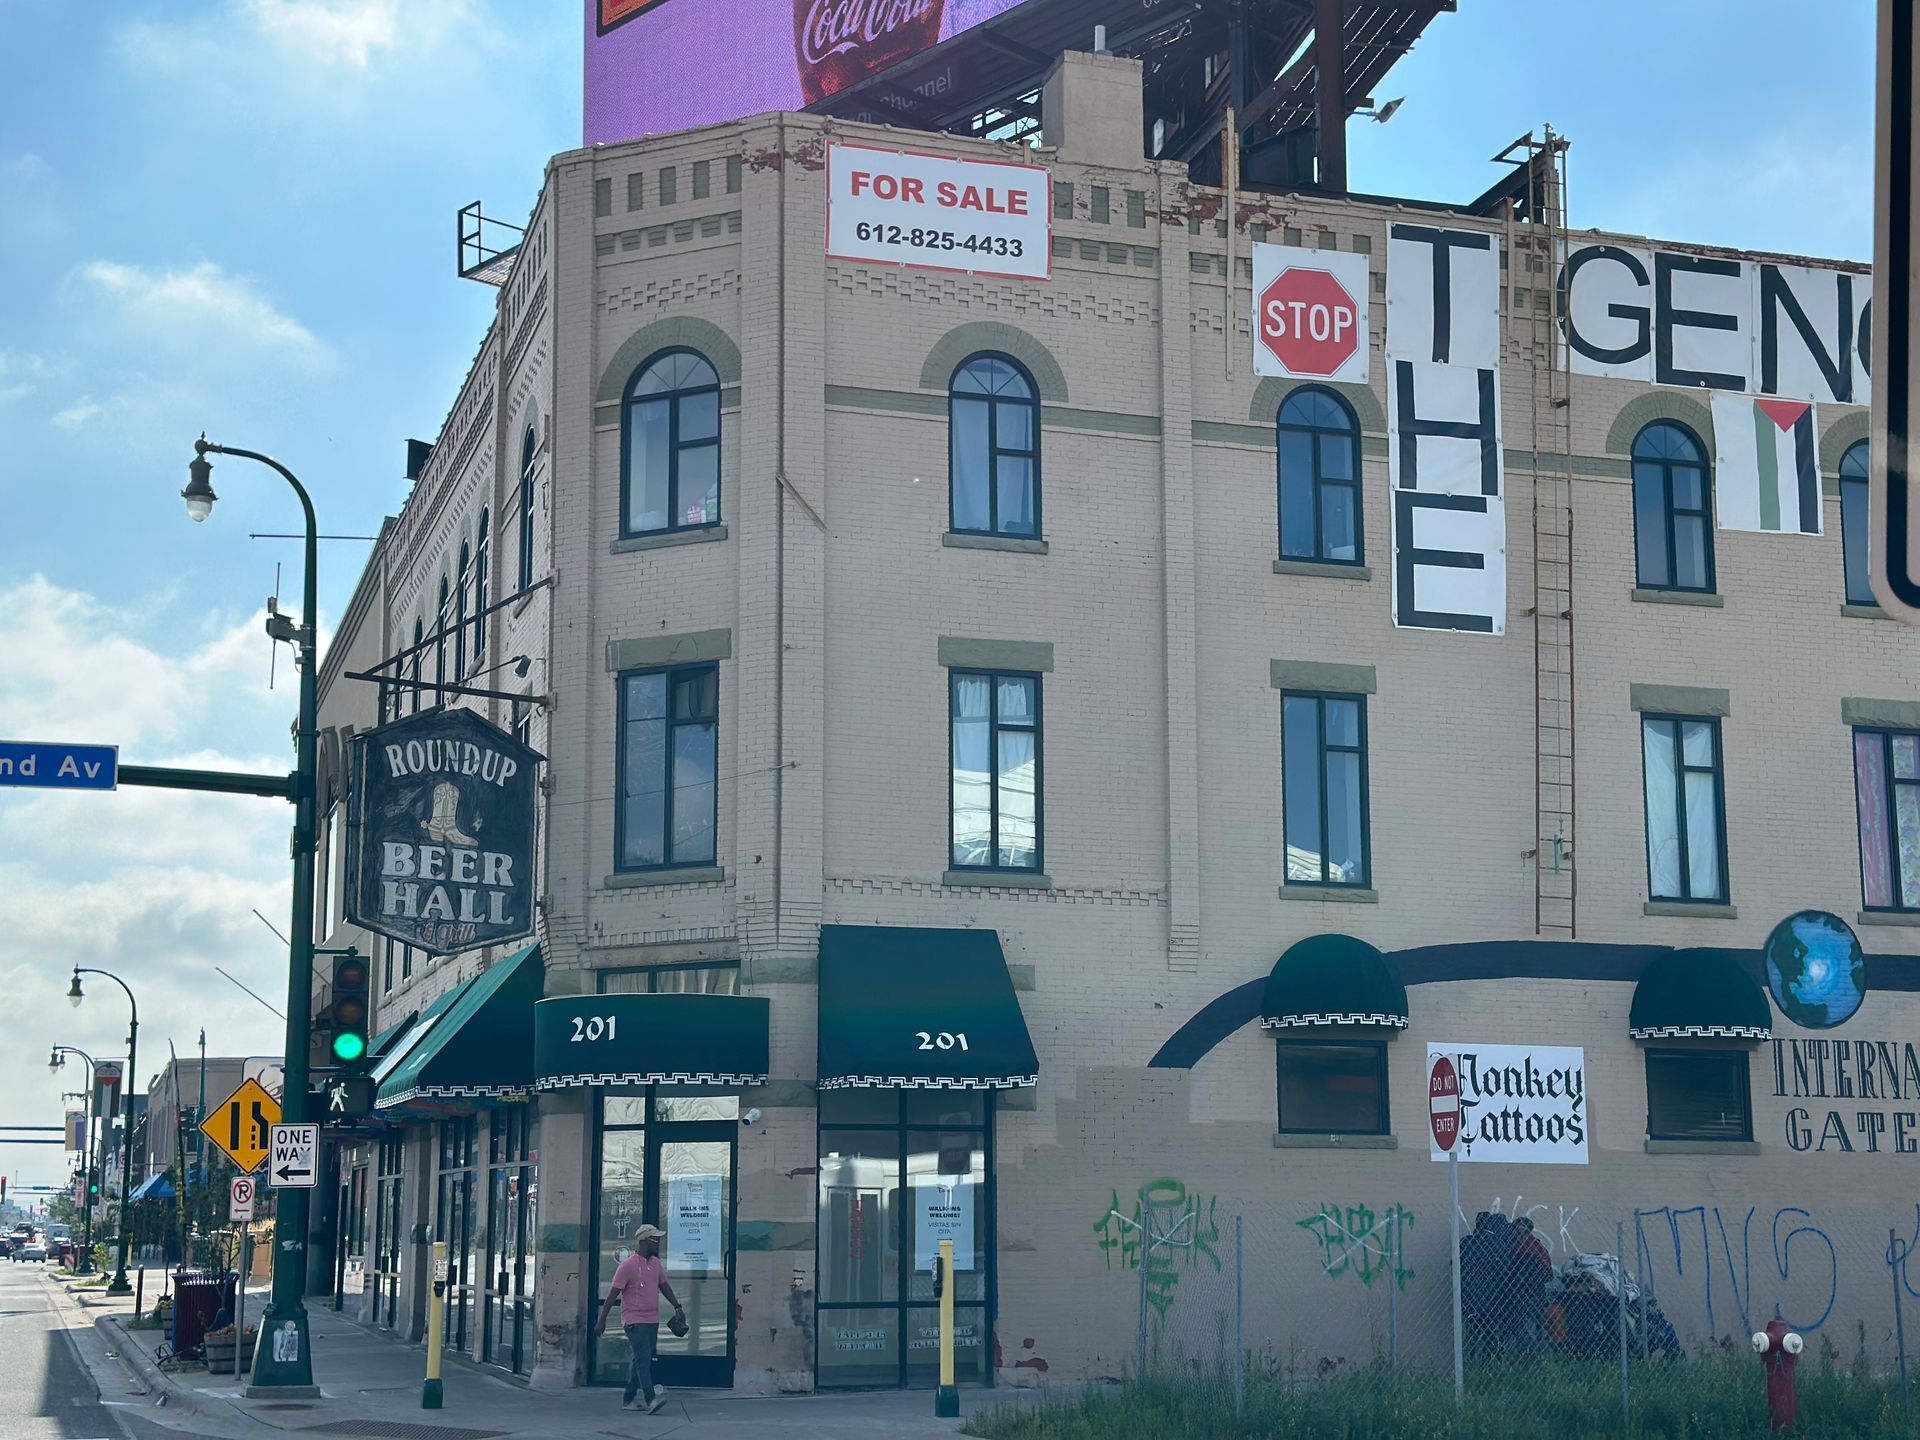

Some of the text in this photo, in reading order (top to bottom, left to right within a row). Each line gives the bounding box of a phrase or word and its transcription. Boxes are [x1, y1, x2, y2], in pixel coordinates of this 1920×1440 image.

[851, 171, 1028, 216] FOR SALE
[856, 222, 1023, 258] 612-825-4433
[1265, 300, 1353, 343] STOP
[1557, 245, 1872, 404] GEN
[1391, 223, 1498, 633] THE
[57, 755, 101, 778] Av
[385, 739, 517, 787] ROUNDUP
[381, 841, 515, 887] BEER
[382, 881, 515, 925] HALL
[570, 1015, 616, 1043] 201
[915, 1031, 969, 1052] 201
[1432, 1074, 1455, 1091] DO NOT
[1772, 1038, 1920, 1100] INTERNA
[277, 1130, 312, 1144] ONE
[1436, 1117, 1455, 1133] ENTER
[1785, 1107, 1920, 1154] GATE
[276, 1147, 311, 1161] WAY
